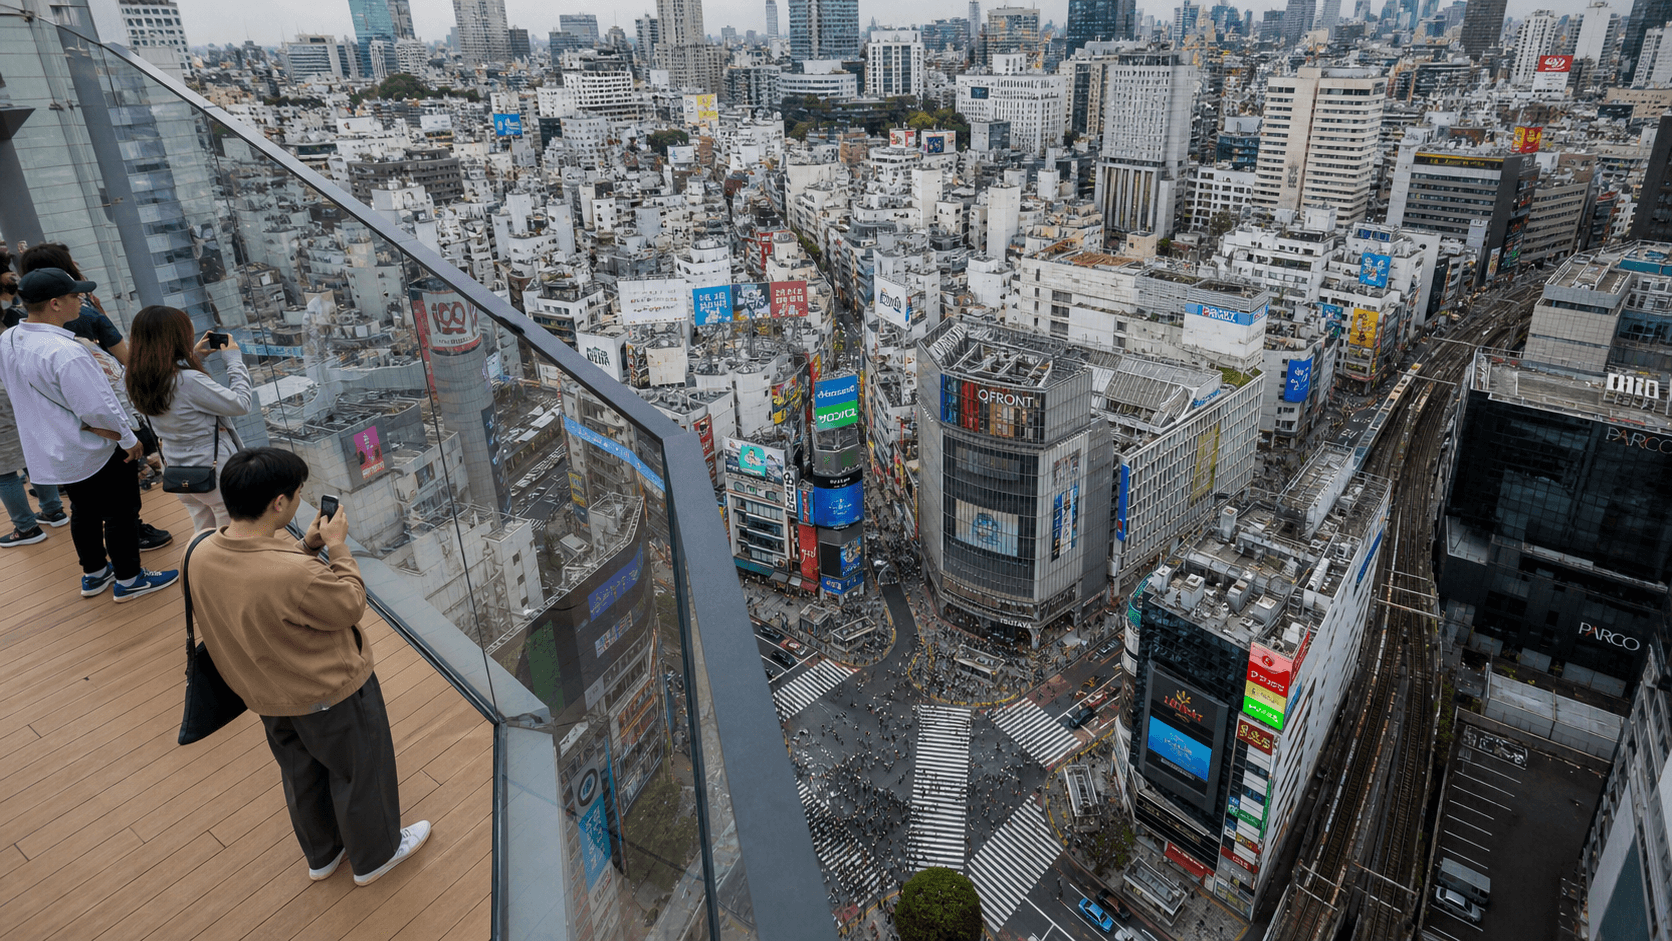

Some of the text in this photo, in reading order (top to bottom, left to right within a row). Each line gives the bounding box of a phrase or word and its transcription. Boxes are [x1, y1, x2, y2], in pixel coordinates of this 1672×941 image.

[978, 389, 1034, 407] QFRONT
[1605, 426, 1672, 454] PARCO
[1578, 622, 1640, 650] PARCO
